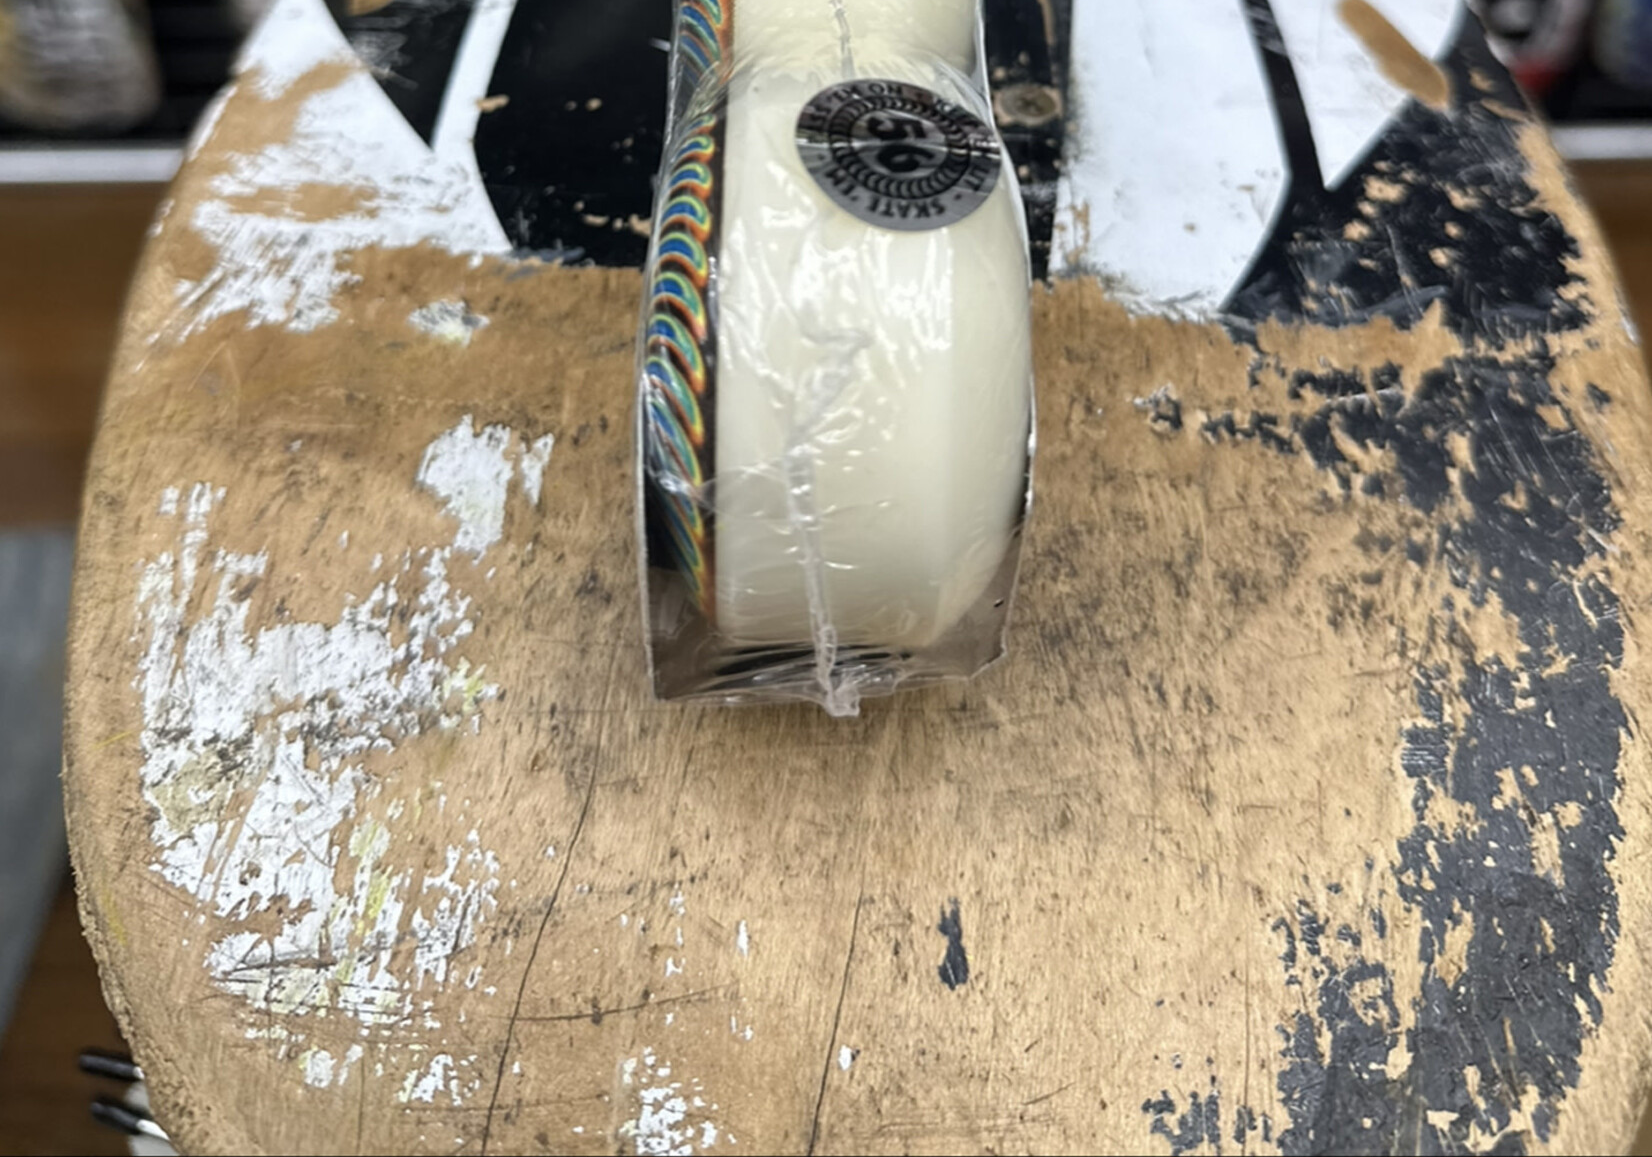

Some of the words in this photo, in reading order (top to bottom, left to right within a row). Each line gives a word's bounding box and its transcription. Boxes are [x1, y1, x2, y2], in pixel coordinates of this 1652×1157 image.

[867, 80, 905, 98] ON
[866, 115, 936, 174] 56
[867, 196, 947, 219] SKATE
